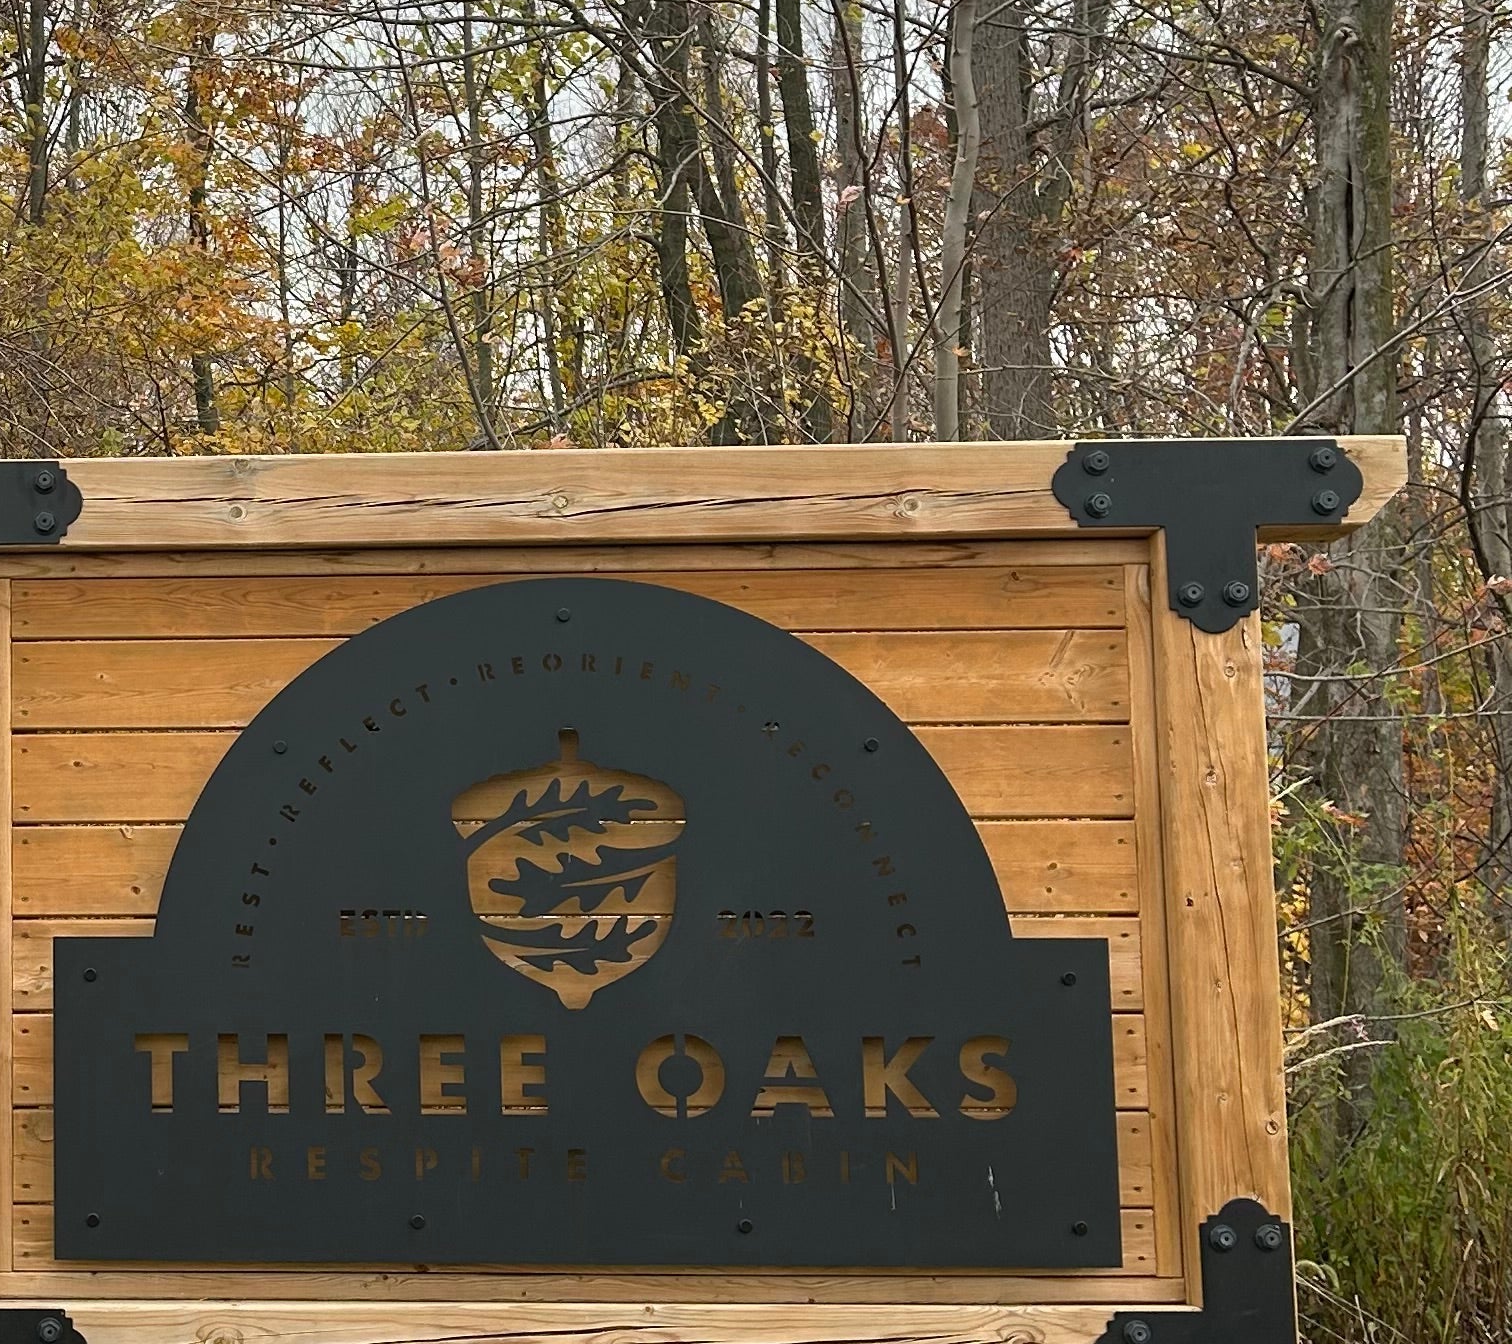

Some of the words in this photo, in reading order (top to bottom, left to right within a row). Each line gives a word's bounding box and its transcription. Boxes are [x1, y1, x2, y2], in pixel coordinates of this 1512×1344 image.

[232, 862, 270, 968] REST
[279, 684, 431, 823] REFLECT
[477, 653, 721, 703] REORIENT
[717, 910, 816, 938] 2022
[134, 1032, 549, 1116] THREE
[635, 1032, 1018, 1121] OAKS
[250, 1146, 589, 1183] RESPITE
[660, 1149, 919, 1185] CABIN
